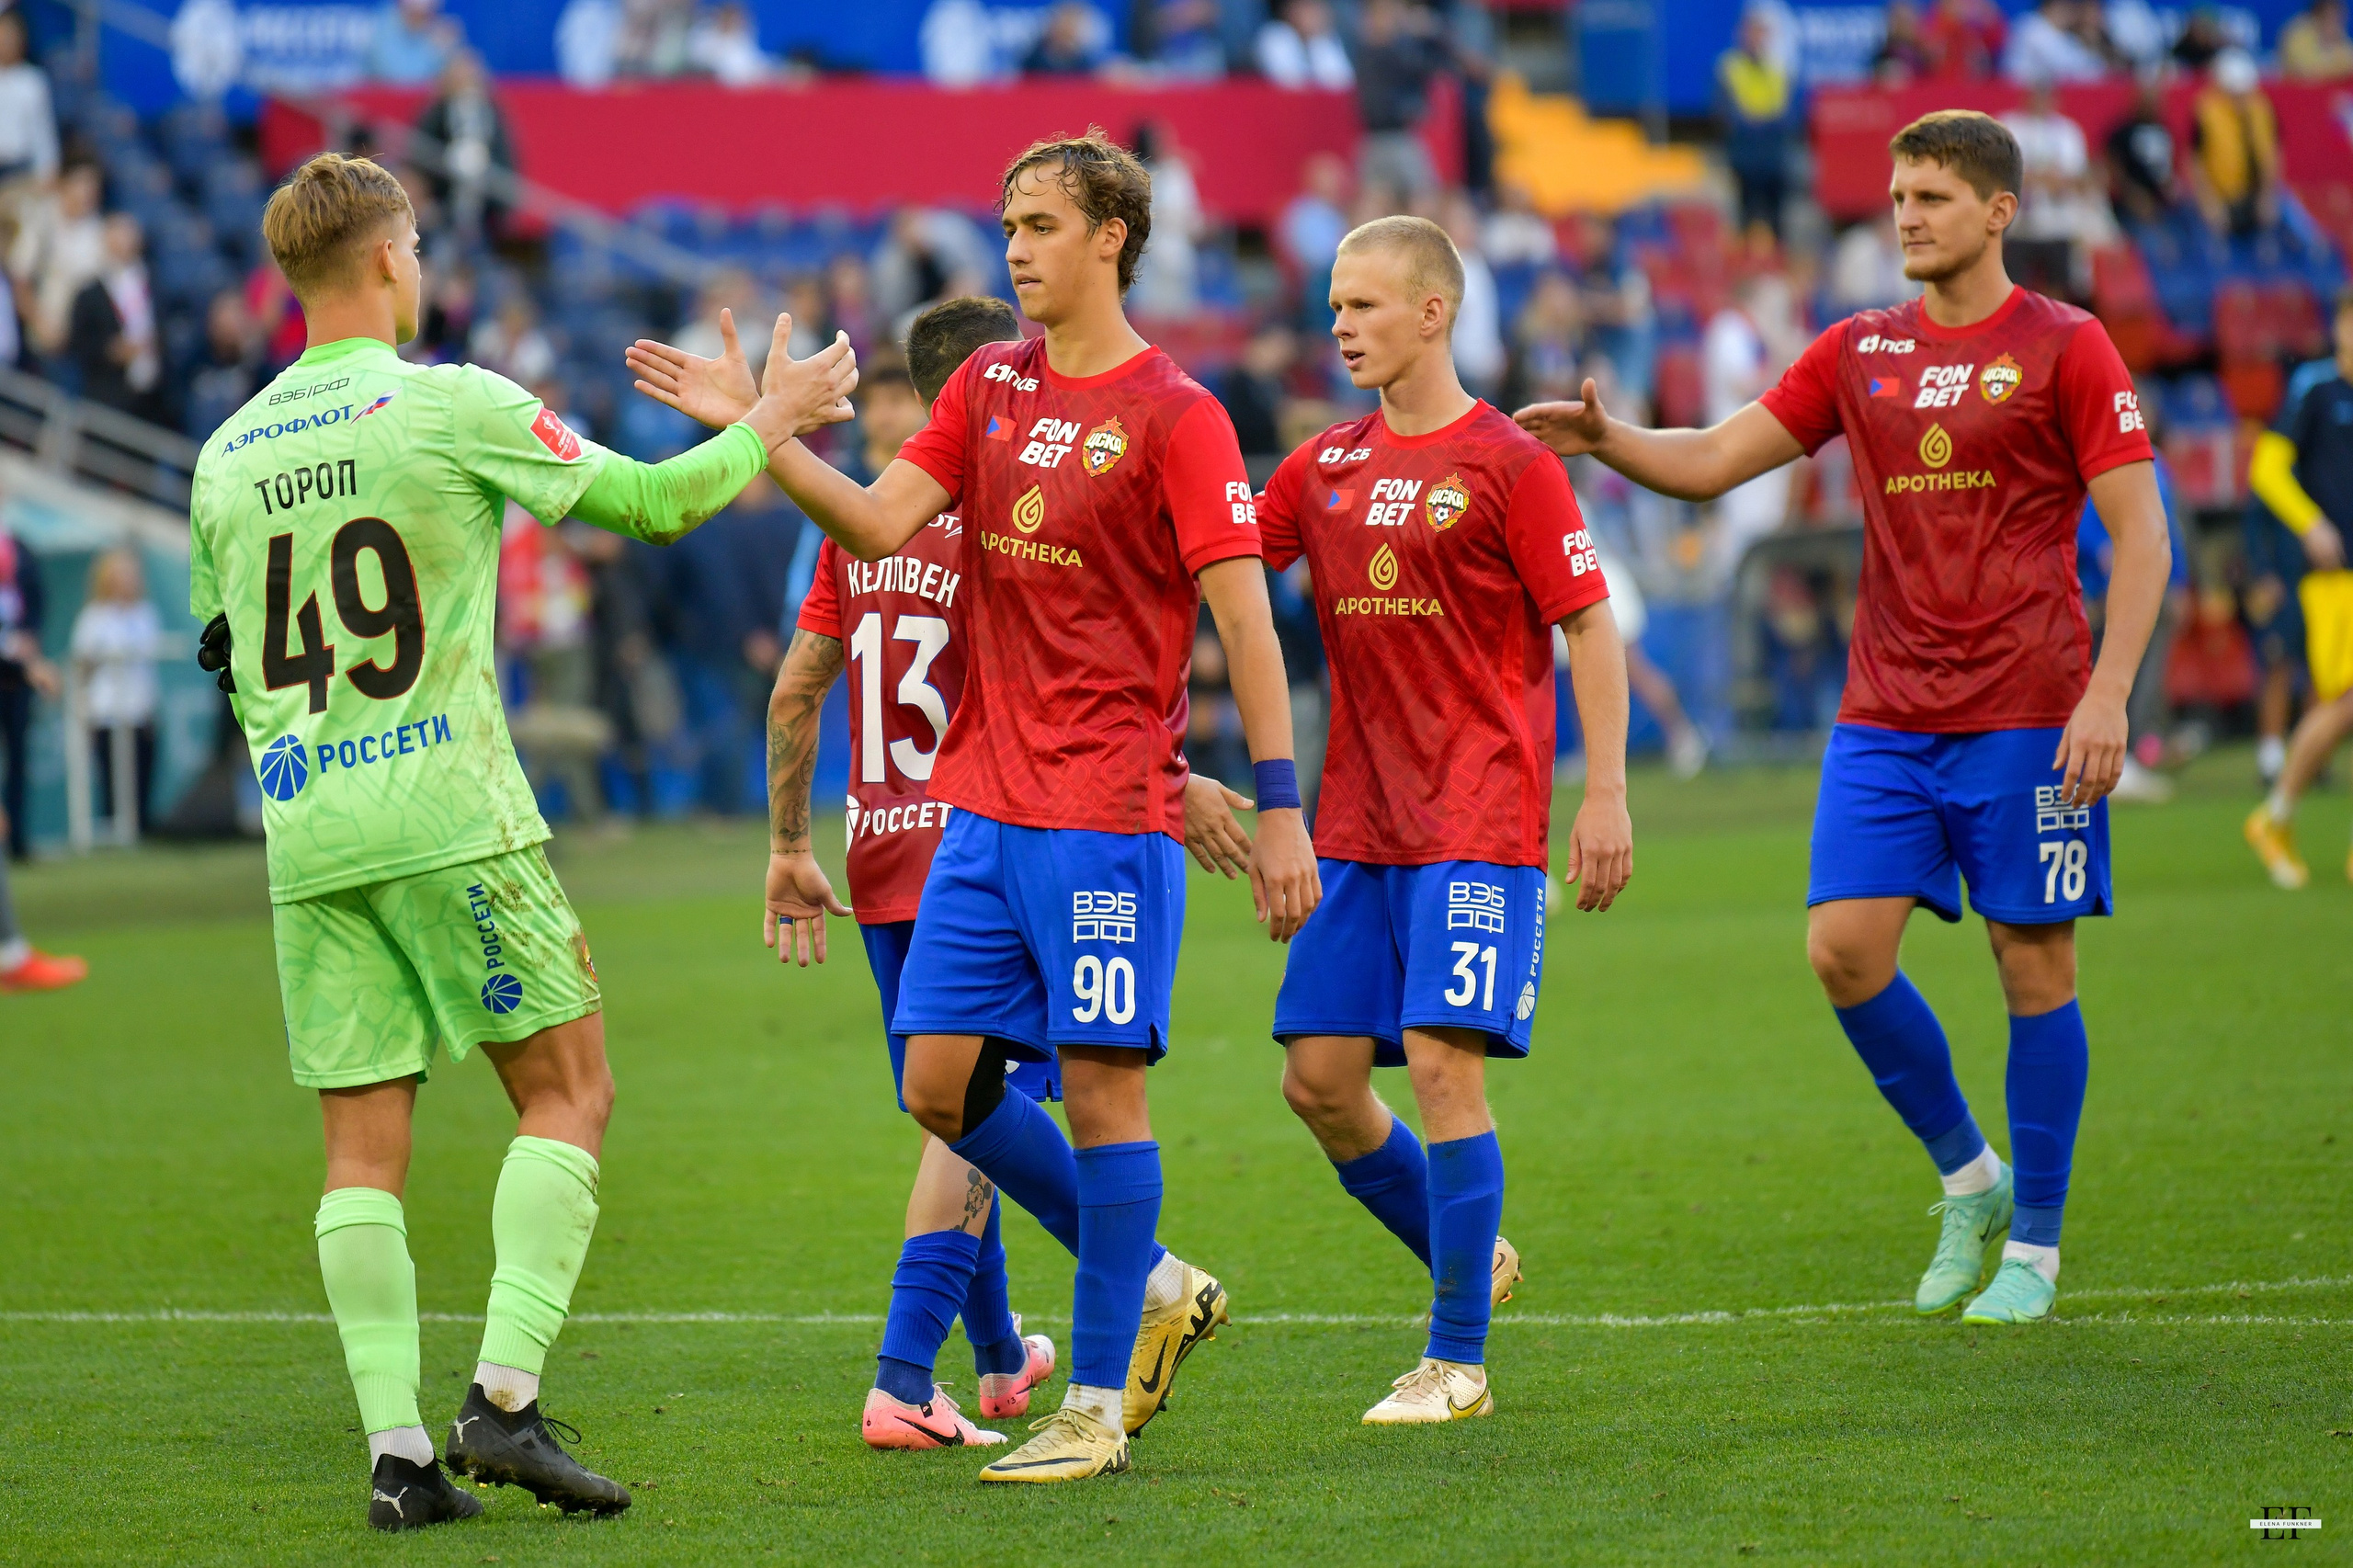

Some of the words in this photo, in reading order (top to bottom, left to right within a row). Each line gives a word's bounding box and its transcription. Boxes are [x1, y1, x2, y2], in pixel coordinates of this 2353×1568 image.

[1880, 338, 1915, 354] ПСБ
[1918, 363, 1975, 387] FON
[1914, 383, 1971, 409] BET
[2114, 390, 2139, 414] FO
[222, 404, 354, 458] АЭРОФЛОТ
[1029, 417, 1081, 444] FON
[2120, 409, 2145, 434] BE
[1018, 440, 1073, 469] BET
[1085, 431, 1122, 455] ЦСКА
[254, 460, 357, 516] ТОРОП
[1370, 478, 1423, 502] FON
[1885, 470, 1997, 494] APOTHEKA
[1427, 489, 1464, 509] ЦСКА
[1232, 503, 1257, 525] BE
[1365, 502, 1415, 527] BET
[980, 530, 1084, 568] APOTHEKA
[847, 556, 961, 608] КЕЛЛВЕН
[262, 517, 425, 715] 49
[1336, 597, 1444, 616] APOTHEKA
[851, 612, 949, 783] 13
[317, 713, 452, 773] РОССЕТИ
[2040, 839, 2088, 903] 78
[1073, 891, 1137, 915] ВЭБ
[1449, 881, 1506, 908] ВЭБ
[466, 883, 505, 970] РОССЕТИ
[1073, 920, 1136, 945] РФ
[1448, 910, 1505, 934] РФ
[1529, 887, 1544, 977] РОССЕТИ
[1444, 941, 1497, 1012] 31
[1073, 955, 1136, 1025] 90
